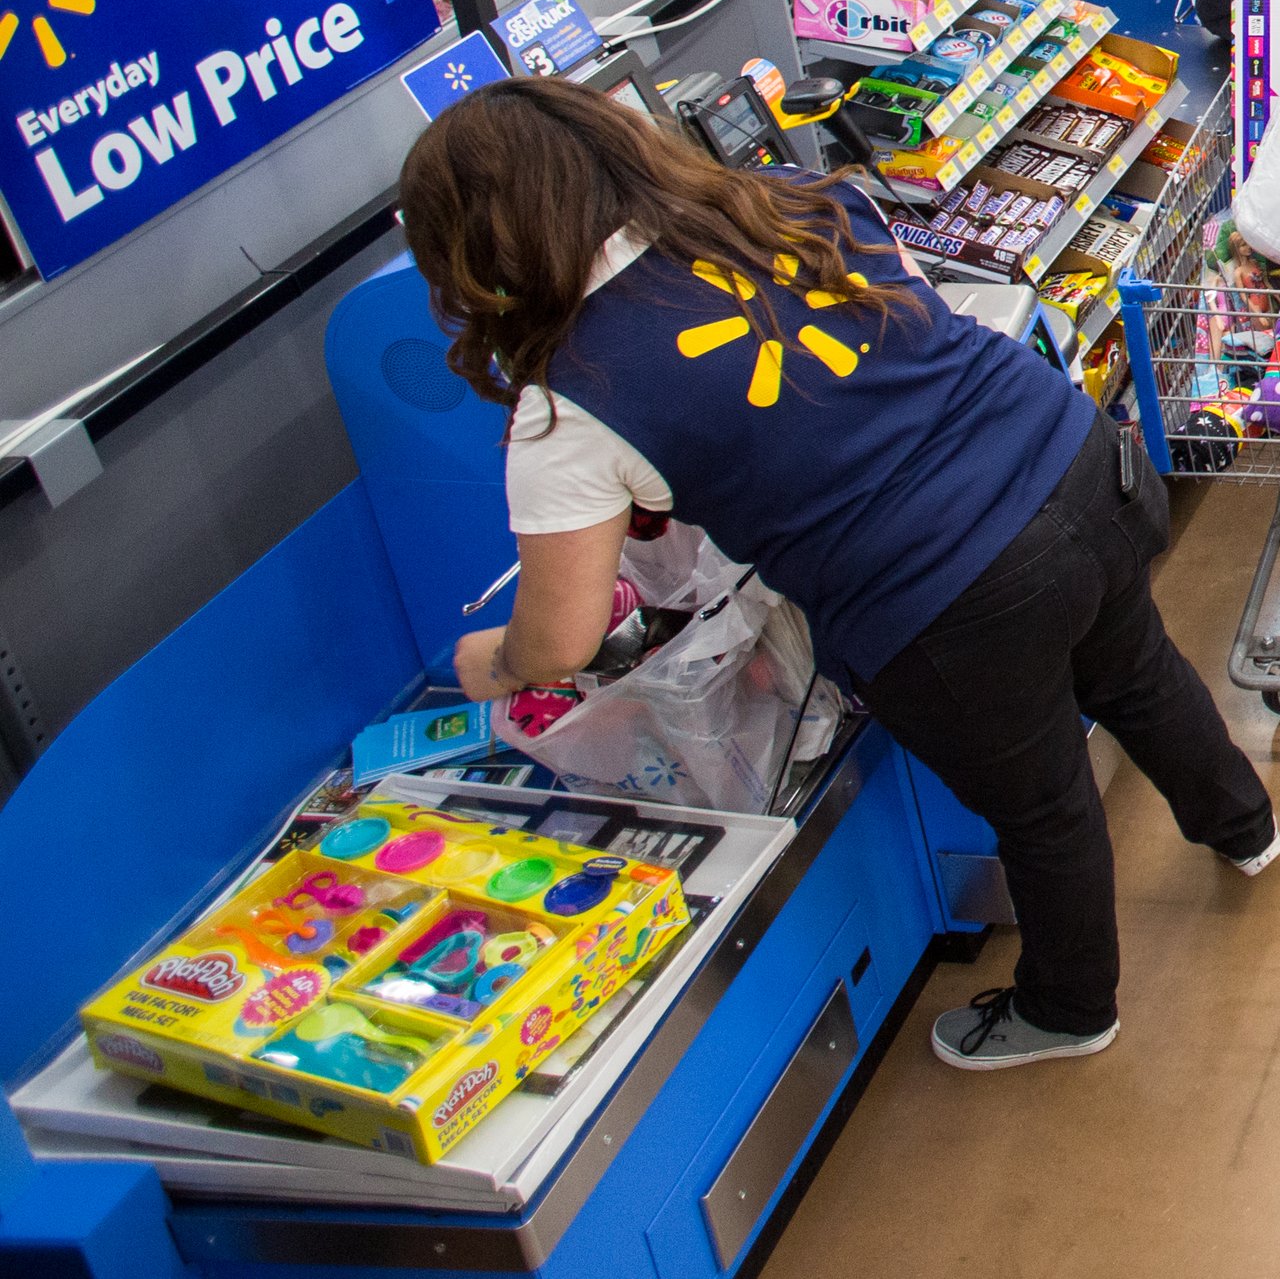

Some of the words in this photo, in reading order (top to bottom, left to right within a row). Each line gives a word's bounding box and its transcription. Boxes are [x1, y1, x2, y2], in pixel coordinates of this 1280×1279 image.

[17, 51, 162, 147] Everyday
[35, 86, 203, 219] Low
[197, 2, 366, 128] Price
[891, 223, 964, 255] SNICKERS
[155, 957, 236, 997] Play-Doh
[122, 1005, 156, 1021] MEGA
[156, 1015, 181, 1028] SET
[126, 991, 150, 1004] FUN
[150, 995, 203, 1019] FACTORY
[434, 1063, 494, 1122] Play-Doh
[437, 1119, 459, 1142] FUN
[459, 1075, 505, 1119] FACTORY
[441, 1119, 472, 1150] MEGA
[471, 1102, 490, 1122] SET
